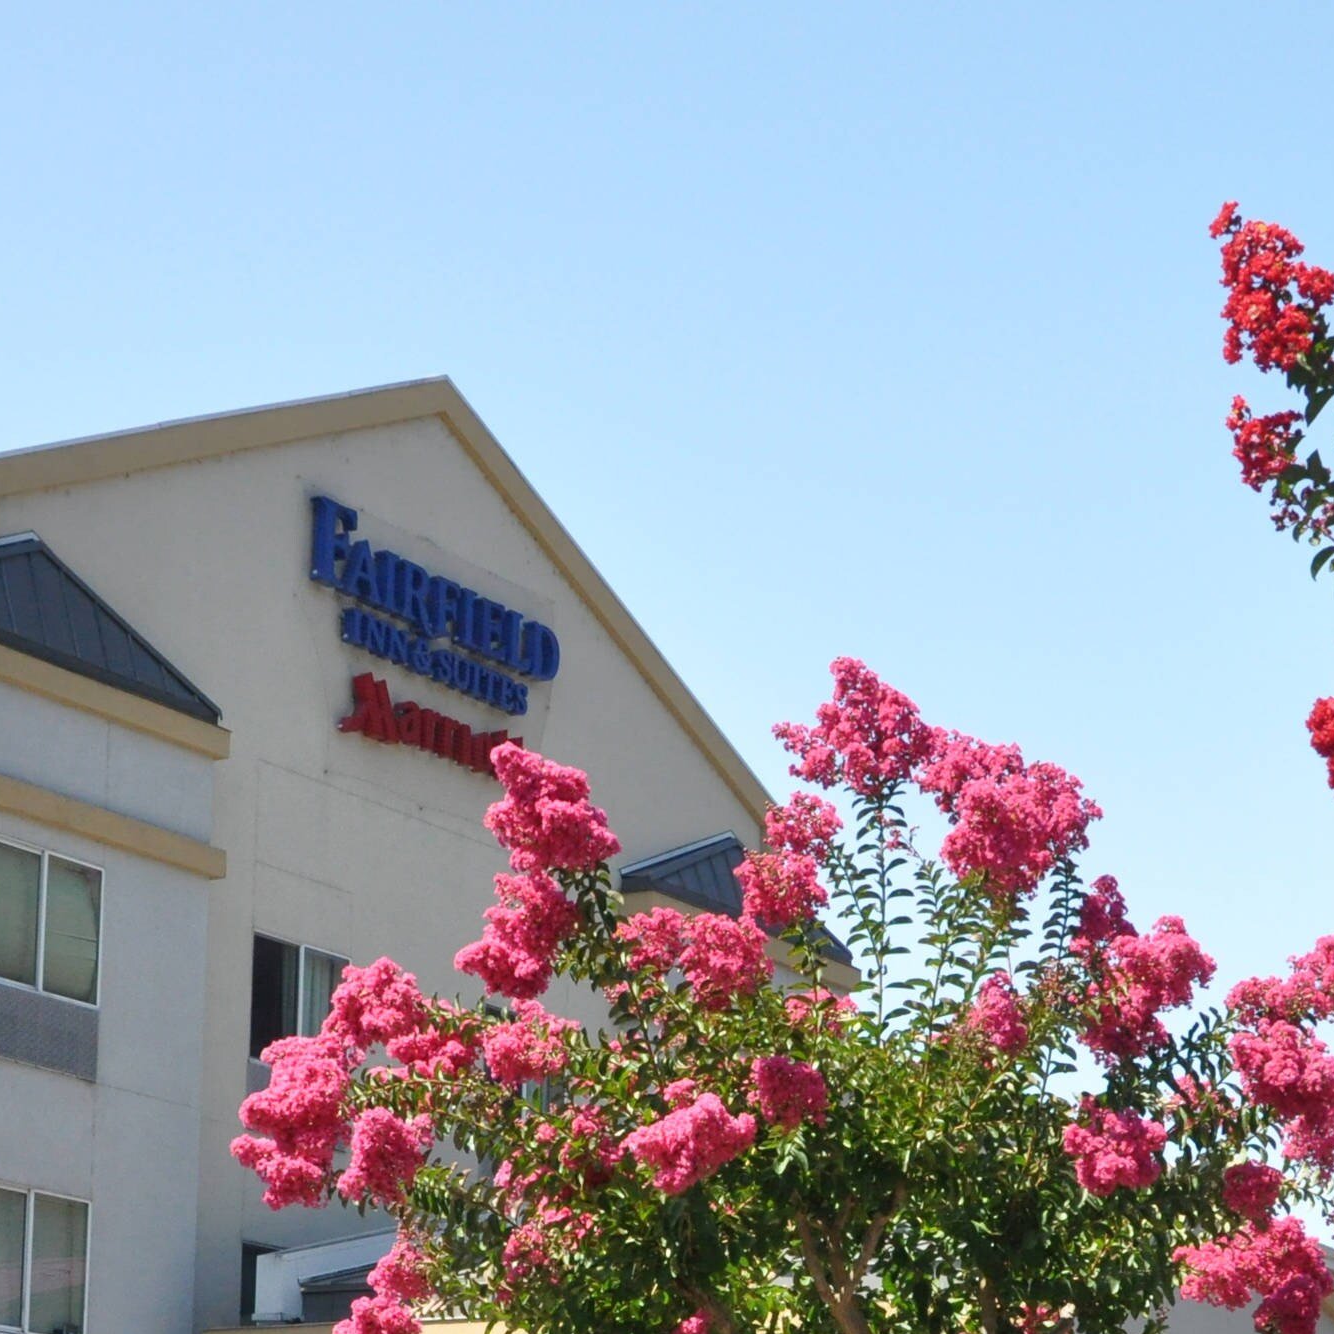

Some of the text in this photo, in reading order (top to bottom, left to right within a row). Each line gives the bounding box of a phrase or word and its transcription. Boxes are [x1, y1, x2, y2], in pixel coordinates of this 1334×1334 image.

[310, 495, 560, 681] FAIRFIELD
[340, 607, 411, 665] INN
[431, 650, 528, 716] SUITES
[337, 671, 524, 780] Marrio
